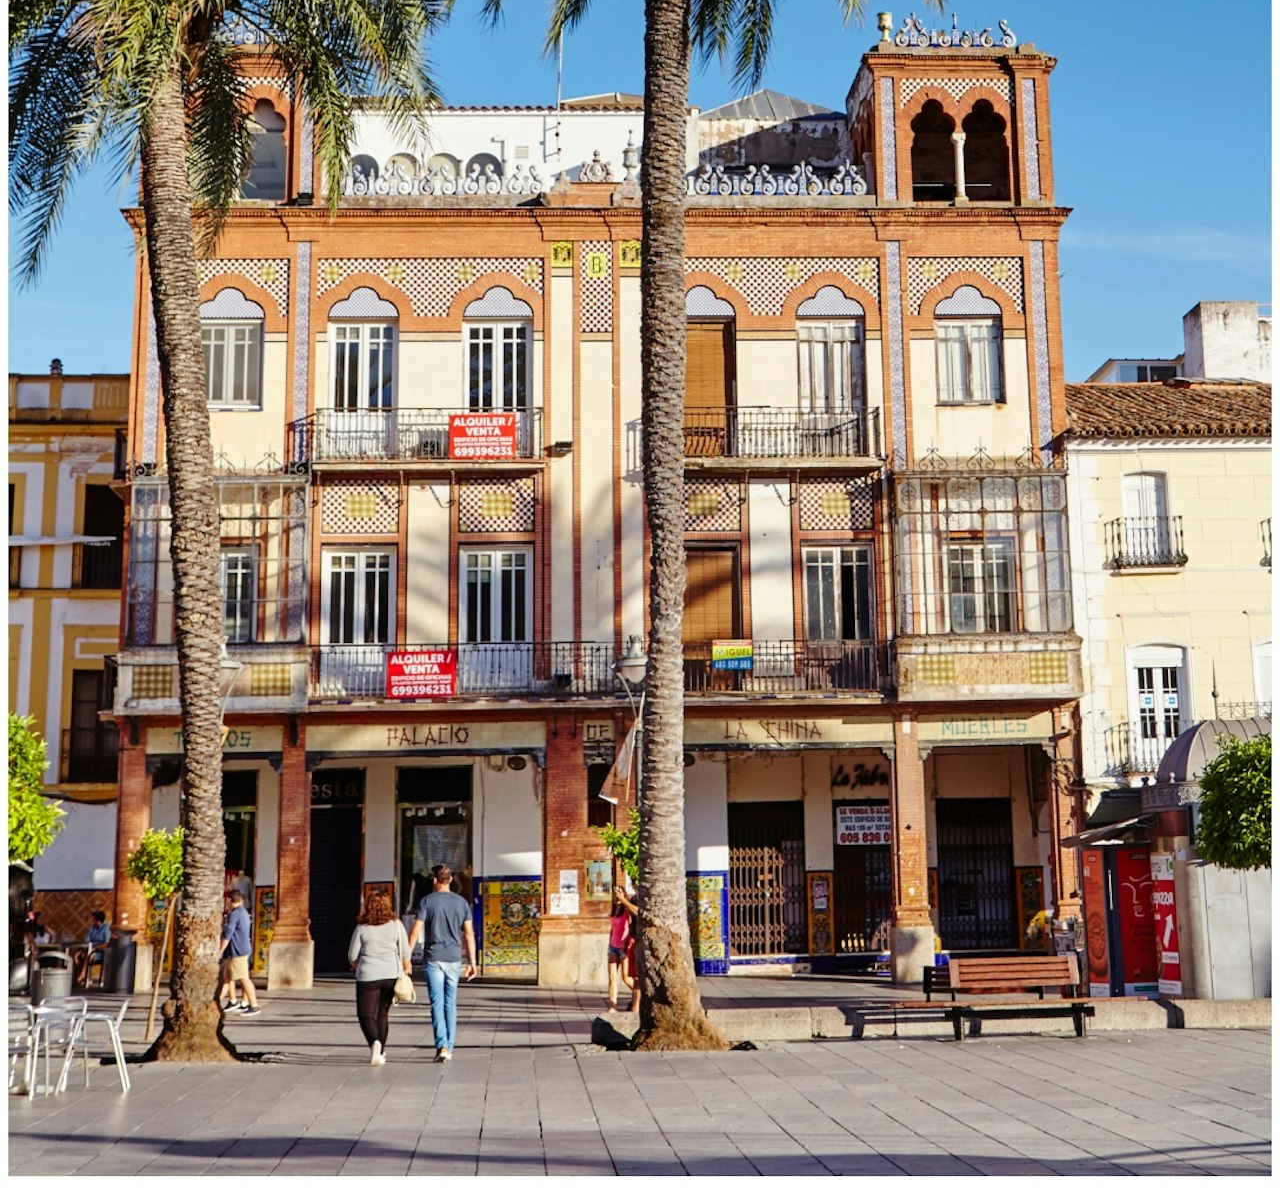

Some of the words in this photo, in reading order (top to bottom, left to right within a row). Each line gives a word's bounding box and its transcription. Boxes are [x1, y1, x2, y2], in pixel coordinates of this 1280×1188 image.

[453, 417, 506, 427] ALQUILER
[465, 427, 501, 436] VENTA
[453, 446, 513, 457] 699396231
[390, 653, 445, 665] ALQUILER
[402, 664, 440, 674] VENTA
[391, 684, 453, 696] 699396231
[723, 720, 749, 740] LA
[941, 716, 1028, 736] MUEBLES
[386, 724, 469, 747] PALACIO
[840, 832, 859, 843] 605
